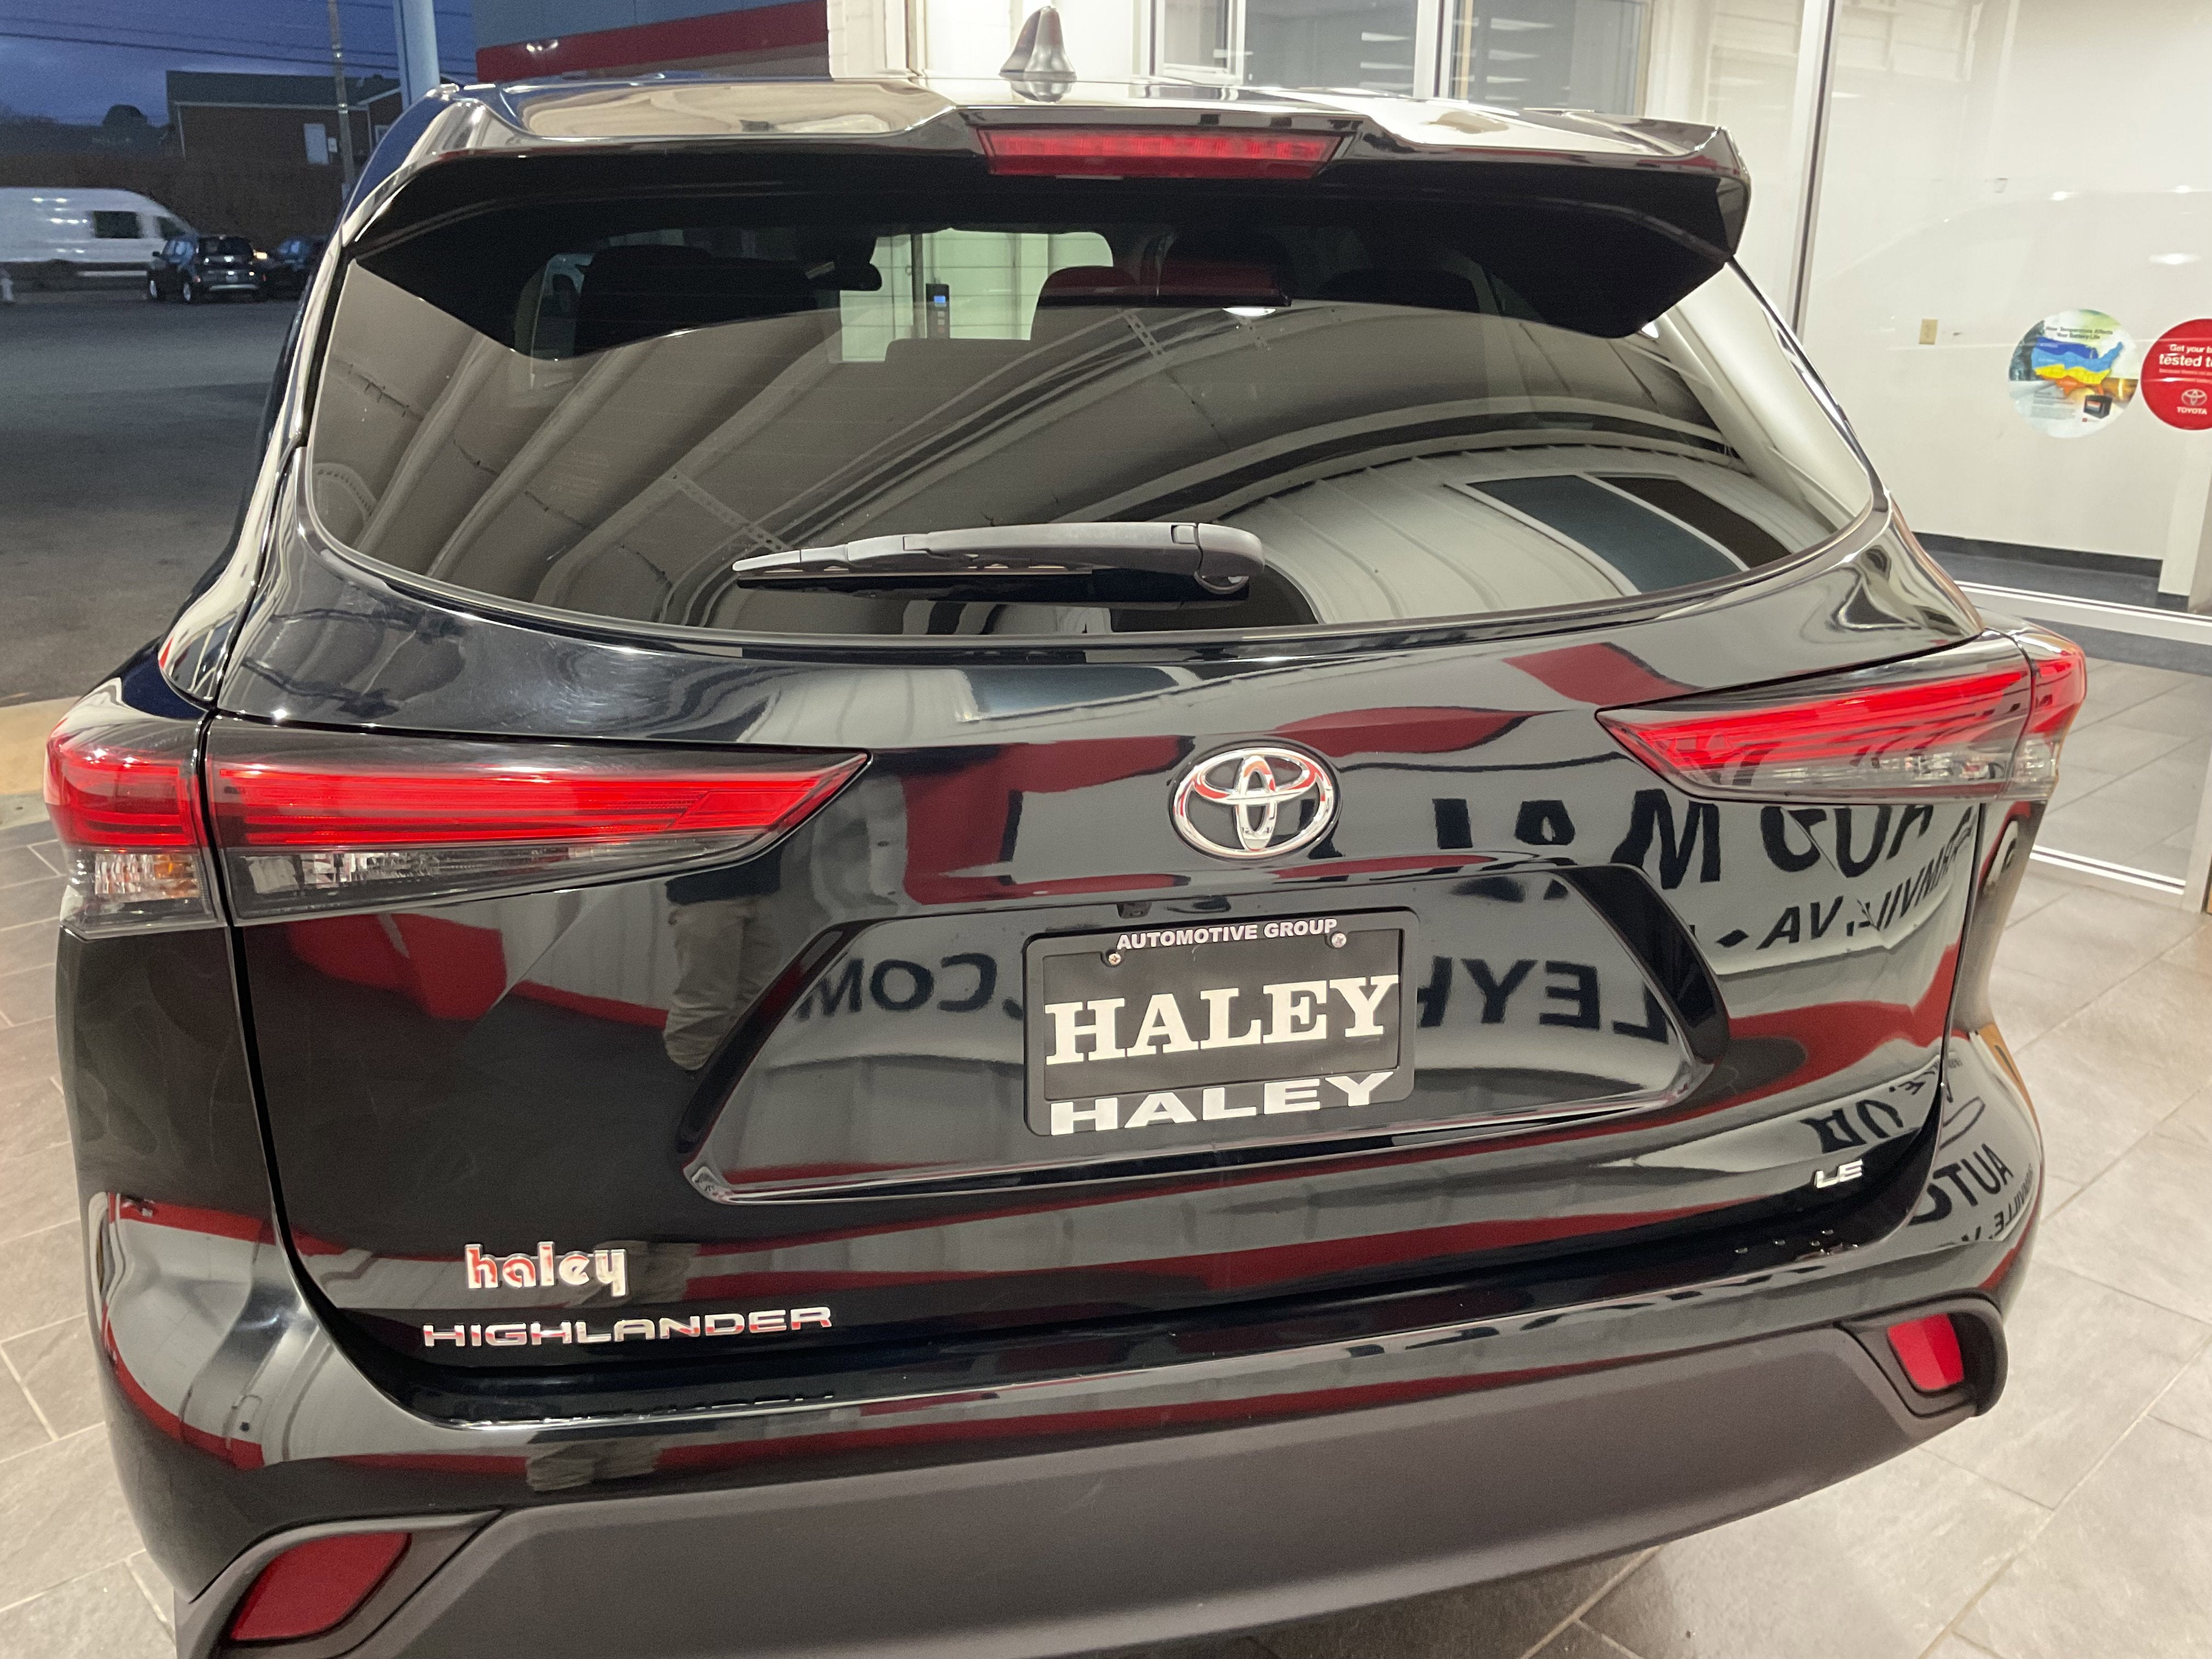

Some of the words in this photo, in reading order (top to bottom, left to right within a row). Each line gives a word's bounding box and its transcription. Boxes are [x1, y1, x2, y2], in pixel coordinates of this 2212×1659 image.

[2159, 353, 2203, 367] tested
[2169, 343, 2185, 352] Get
[2176, 407, 2208, 415] TOYOTA
[1116, 924, 1258, 950] AUTOMOTIVE
[1263, 918, 1337, 939] GROUP
[1045, 974, 1399, 1065] HALEY
[1050, 1071, 1394, 1136] HALEY
[1814, 1159, 1864, 1189] LE
[464, 1241, 628, 1297] haley
[422, 1306, 833, 1347] HIGHLANDER
